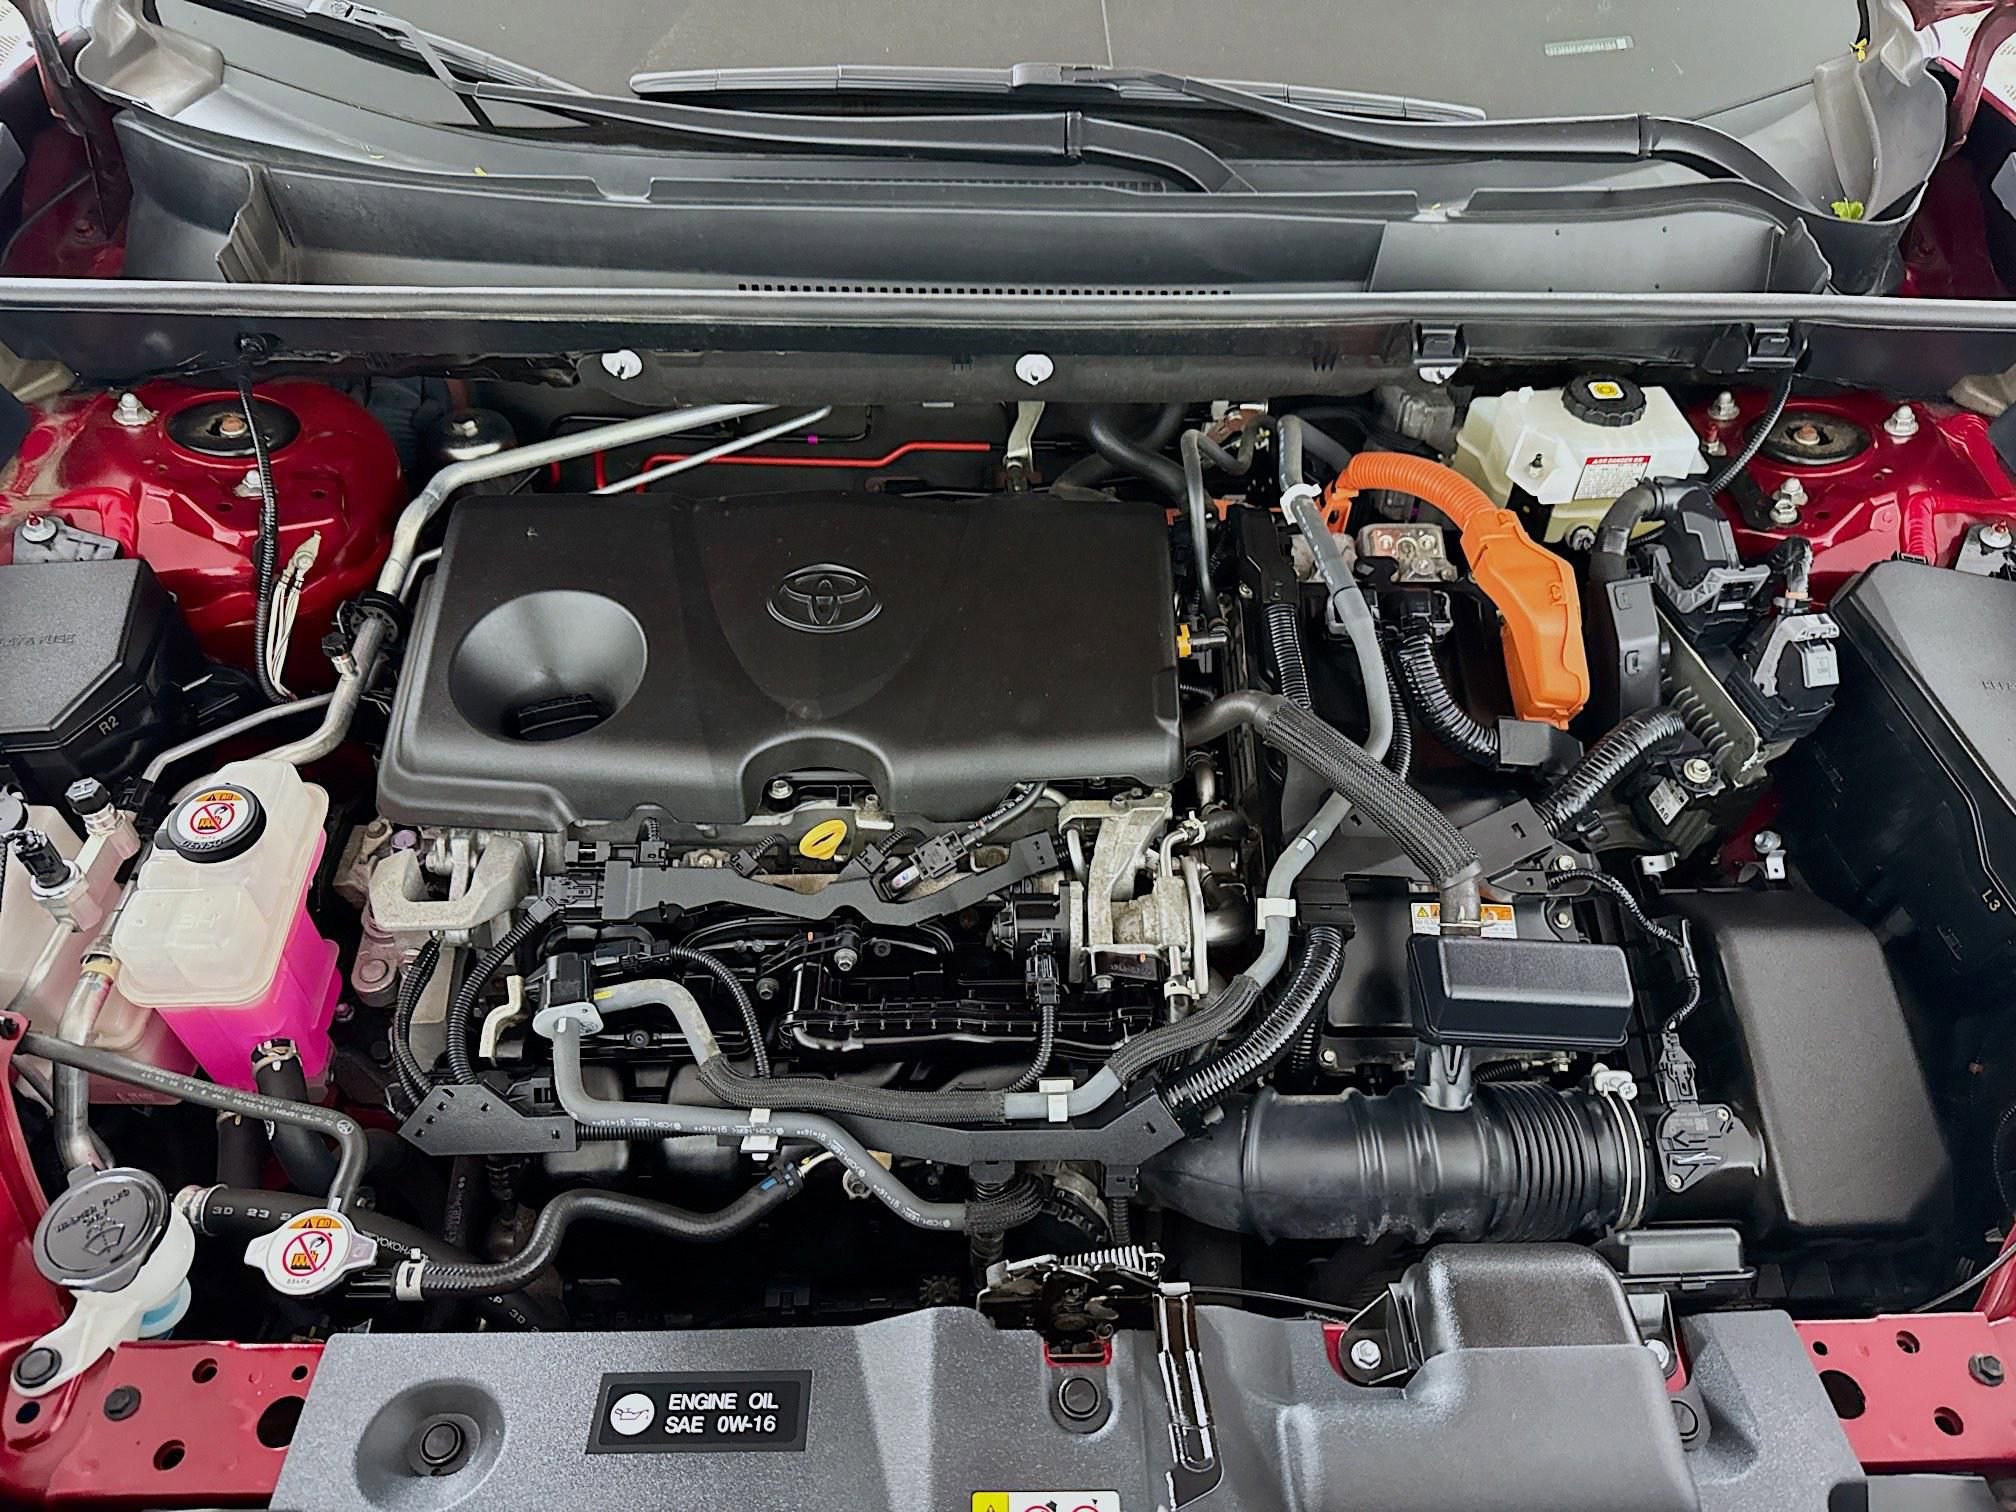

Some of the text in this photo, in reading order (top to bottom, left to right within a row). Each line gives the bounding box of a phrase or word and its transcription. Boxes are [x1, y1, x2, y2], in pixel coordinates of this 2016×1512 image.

[99, 715, 119, 736] R2
[180, 838, 224, 851] DENSO
[1982, 889, 2001, 911] L3
[212, 1206, 234, 1216] 3D
[246, 1208, 270, 1218] 23
[509, 1308, 527, 1324] 3D
[668, 1392, 779, 1410] ENGINE OIL
[664, 1415, 777, 1434] SAE 0W-16
